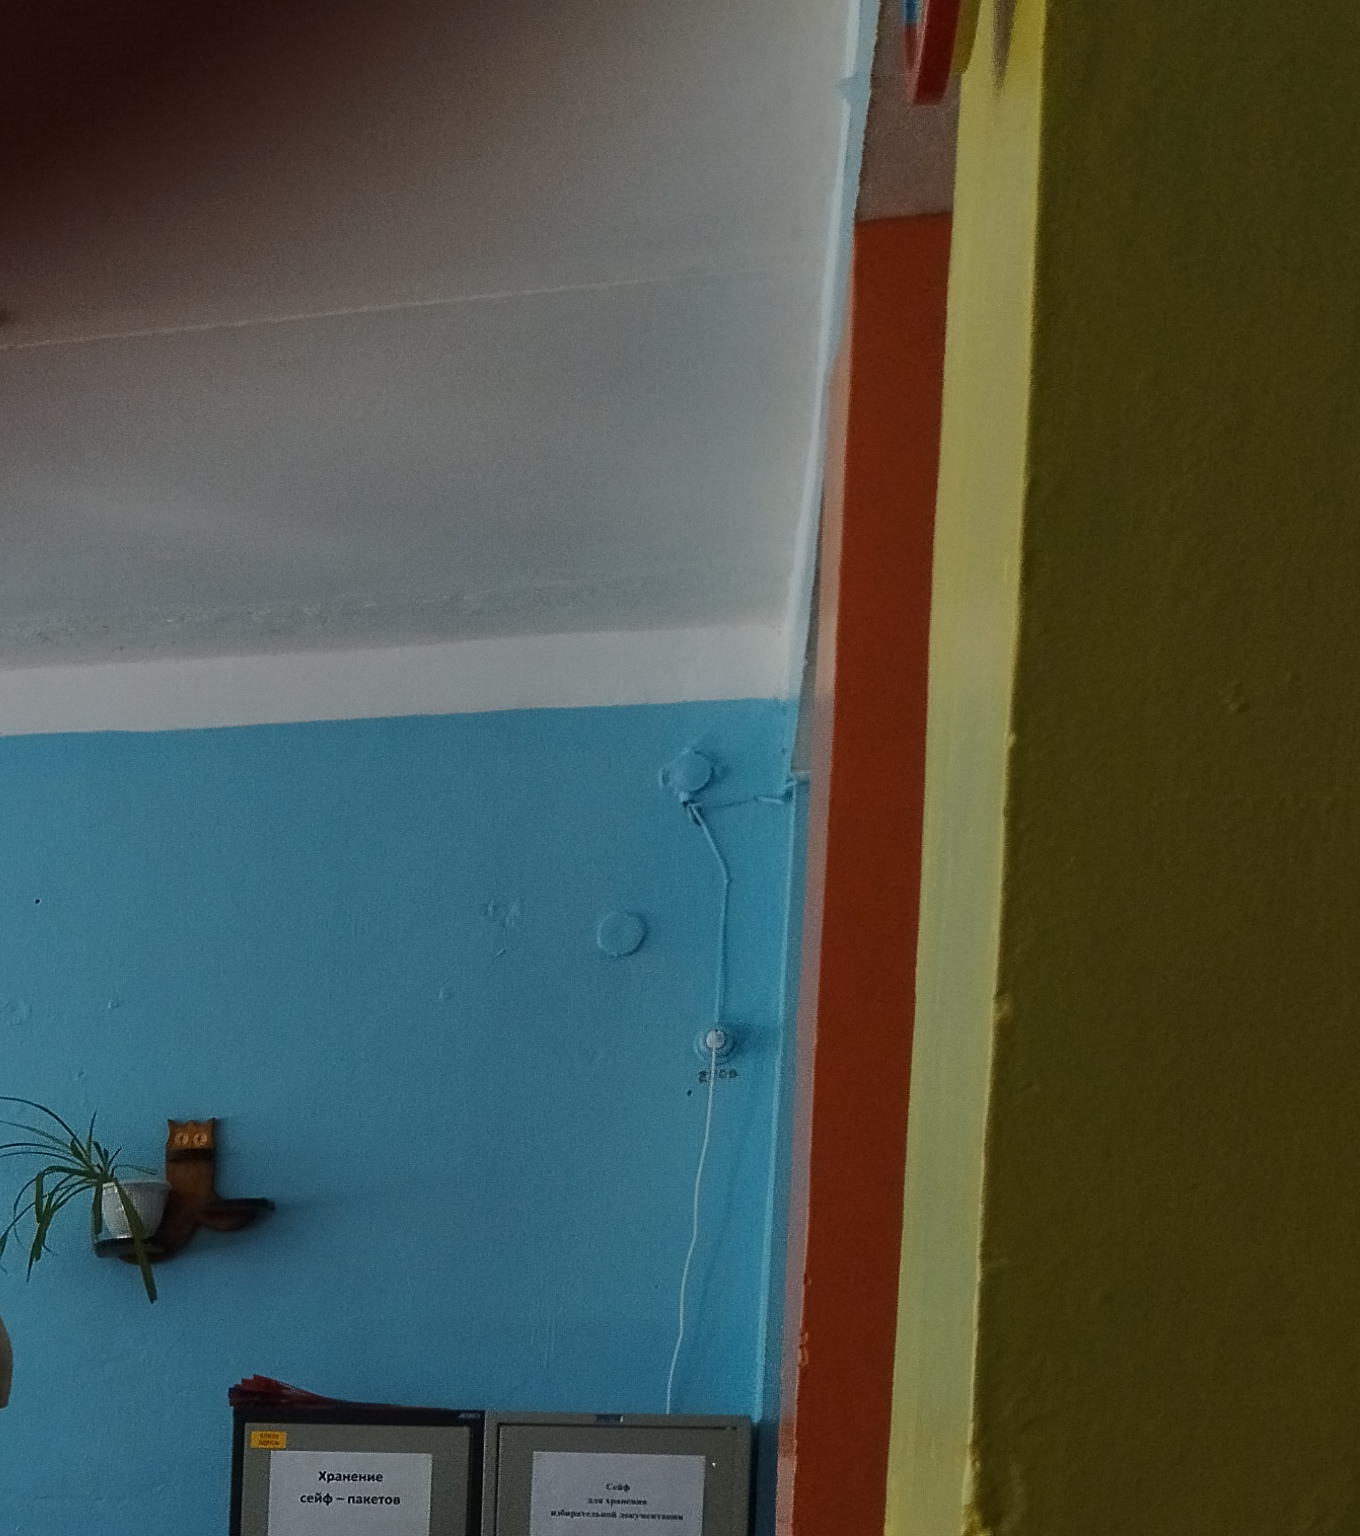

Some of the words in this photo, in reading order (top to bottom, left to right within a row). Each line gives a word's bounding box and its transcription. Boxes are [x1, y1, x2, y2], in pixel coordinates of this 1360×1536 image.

[318, 1470, 384, 1483] Хранение
[606, 1482, 631, 1493] Сейф
[300, 1493, 333, 1506] сейф
[347, 1495, 401, 1505] пакетов
